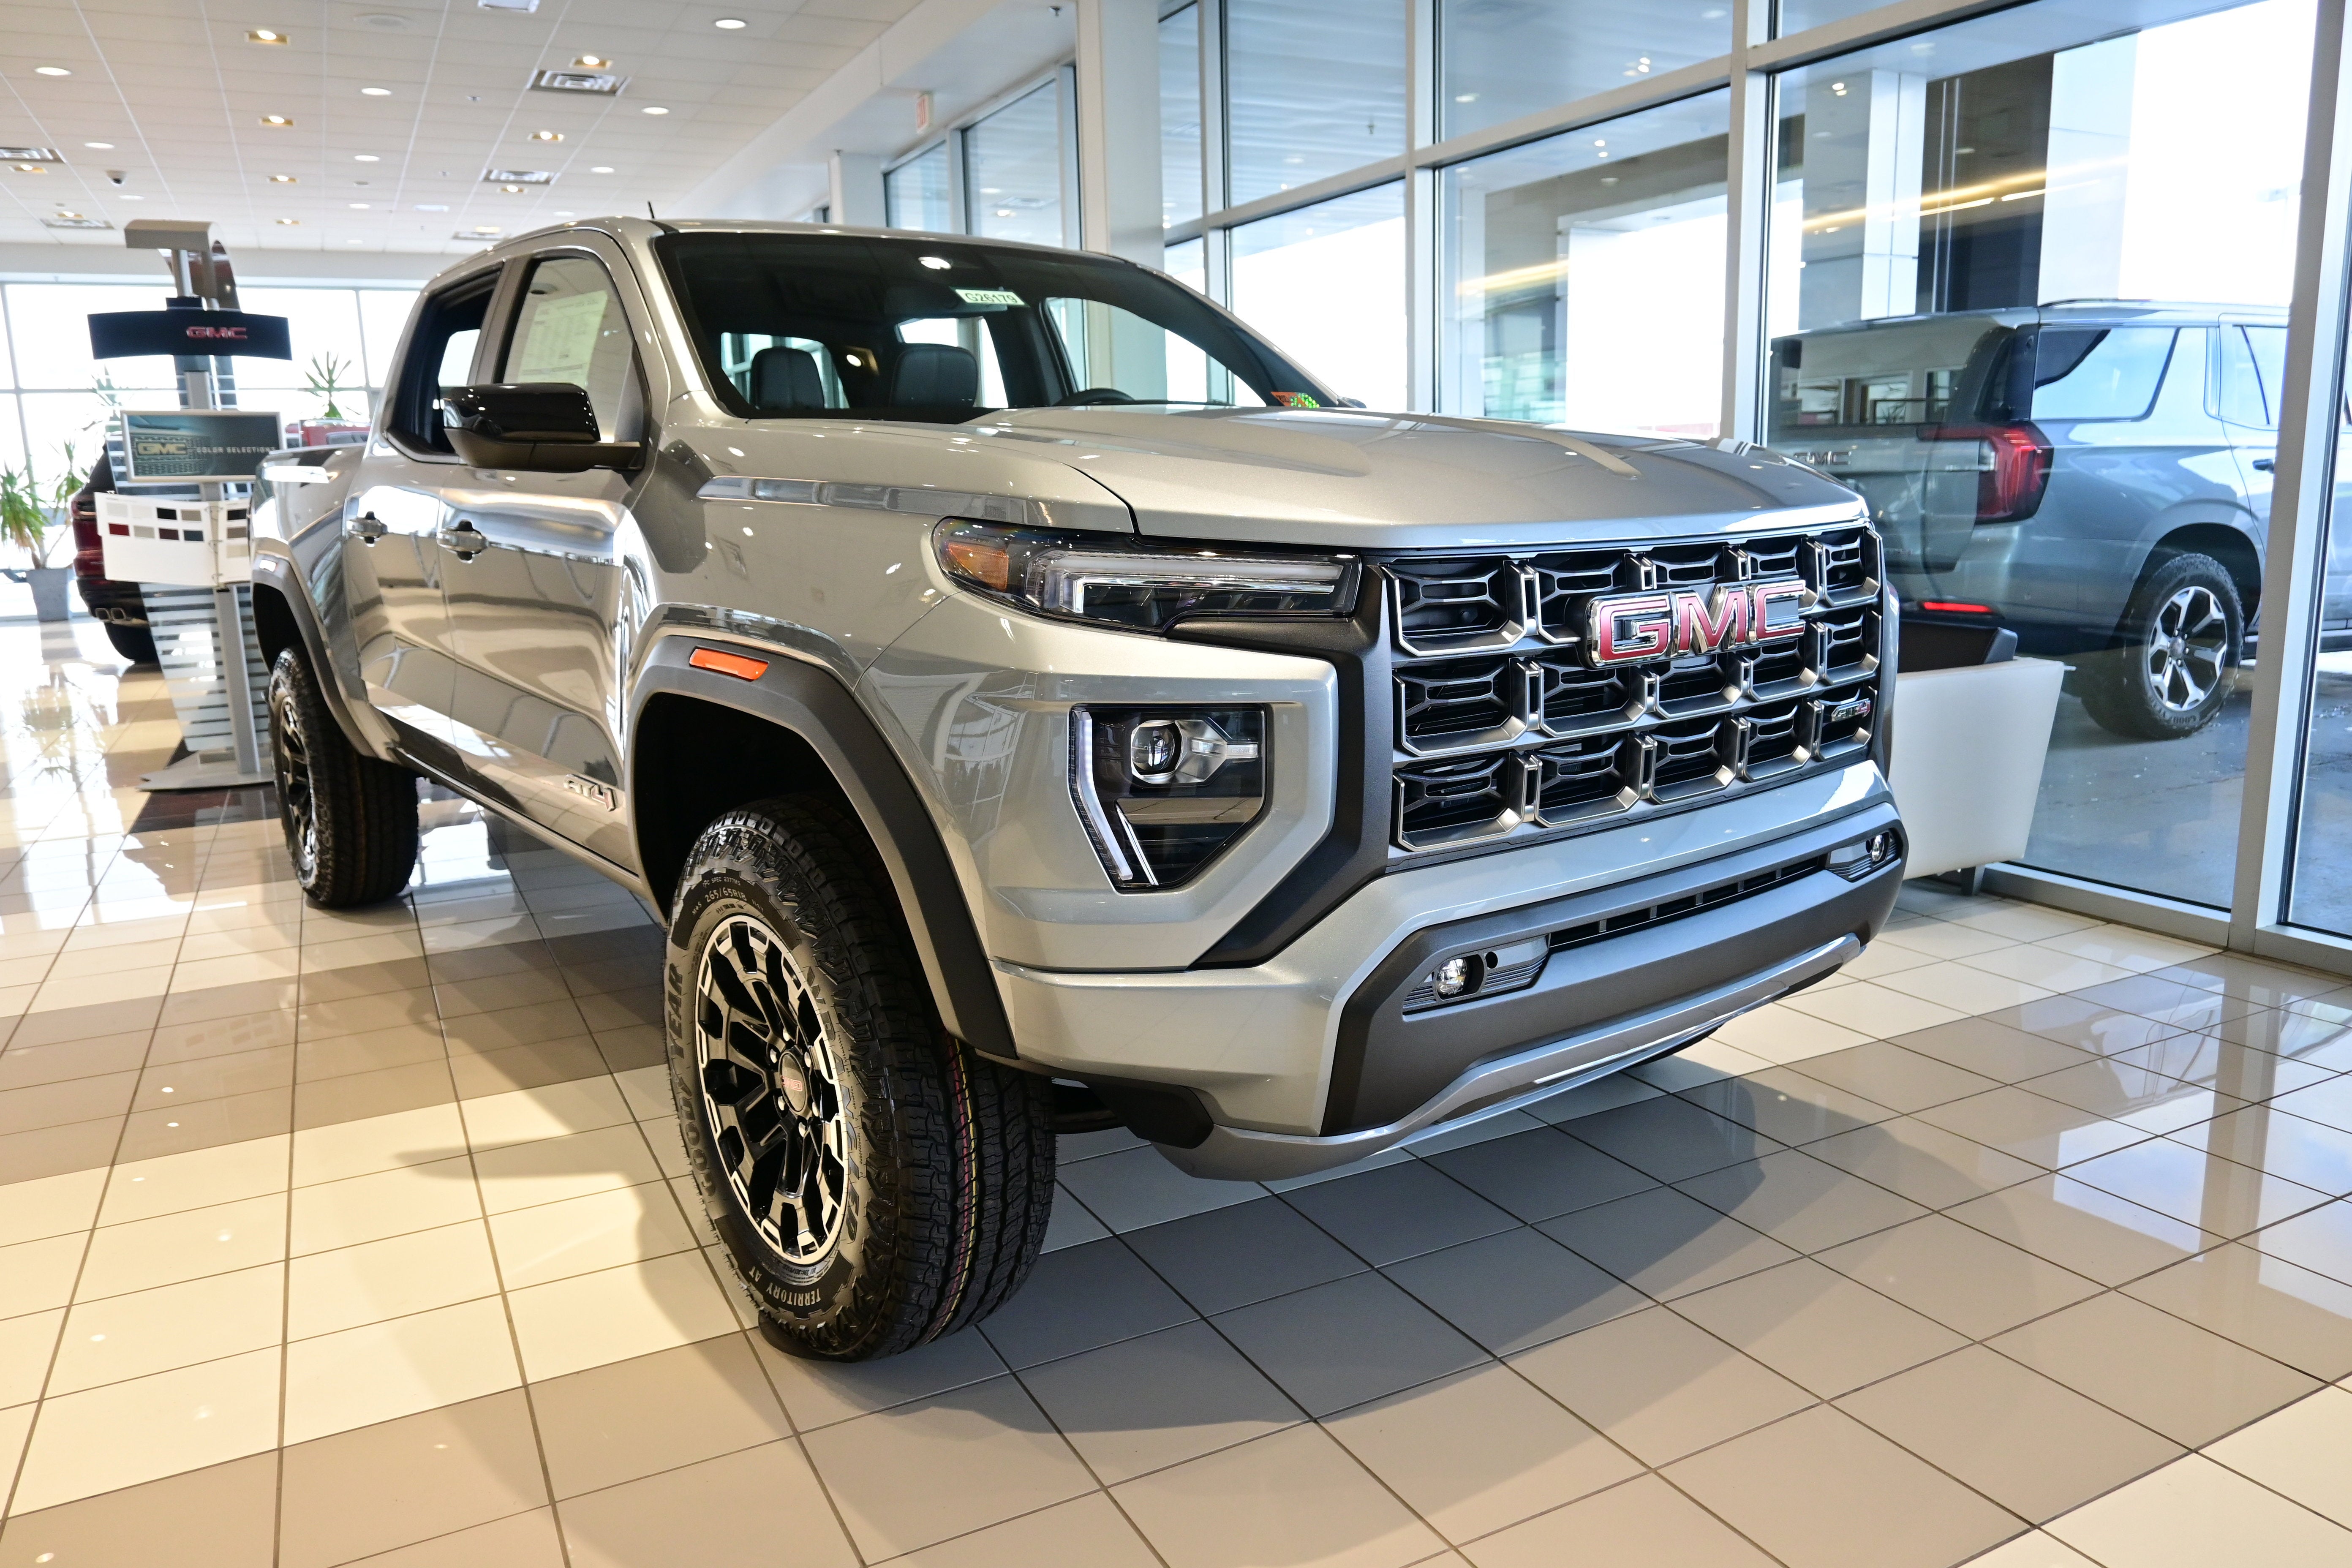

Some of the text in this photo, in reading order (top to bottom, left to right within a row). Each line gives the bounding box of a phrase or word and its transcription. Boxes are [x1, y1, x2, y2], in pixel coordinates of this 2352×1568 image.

[965, 292, 1018, 303] G26179
[186, 326, 248, 339] GMC
[138, 443, 187, 455] GMC
[1591, 580, 1806, 667] GMC
[564, 774, 616, 812] AT4
[705, 887, 747, 903] 265/65R18
[749, 1266, 762, 1282] AT
[766, 1282, 821, 1306] TERRITORY
